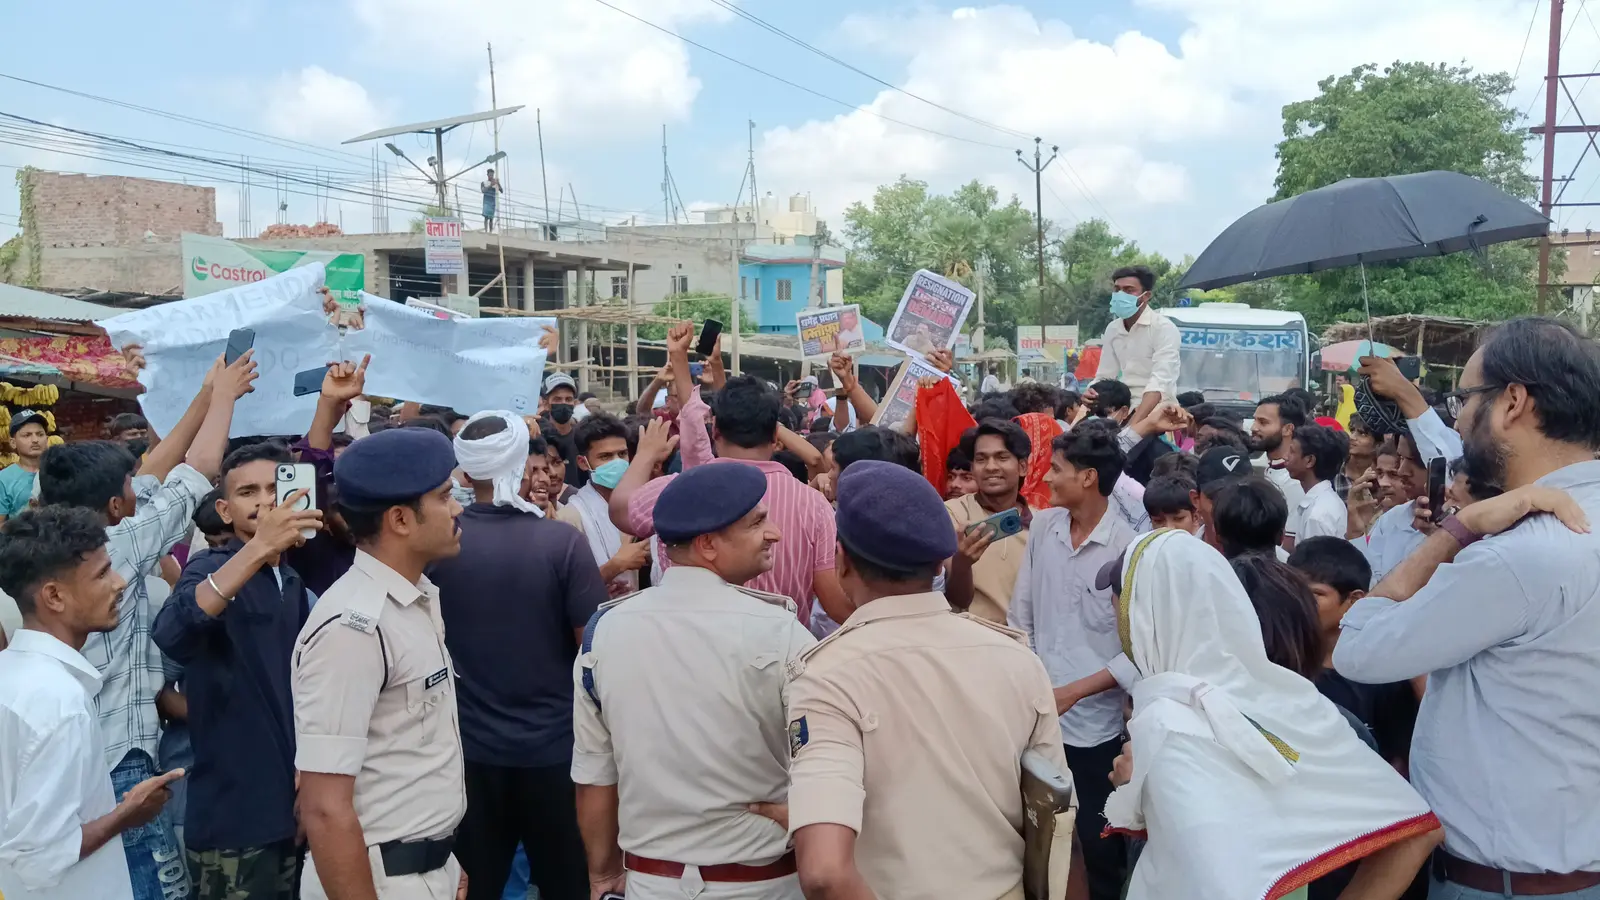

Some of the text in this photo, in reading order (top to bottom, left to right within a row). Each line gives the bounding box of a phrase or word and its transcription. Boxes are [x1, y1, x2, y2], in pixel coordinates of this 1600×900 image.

[426, 217, 444, 236] बेला
[210, 263, 267, 282] Castrol
[915, 275, 967, 306] RESIGNATION
